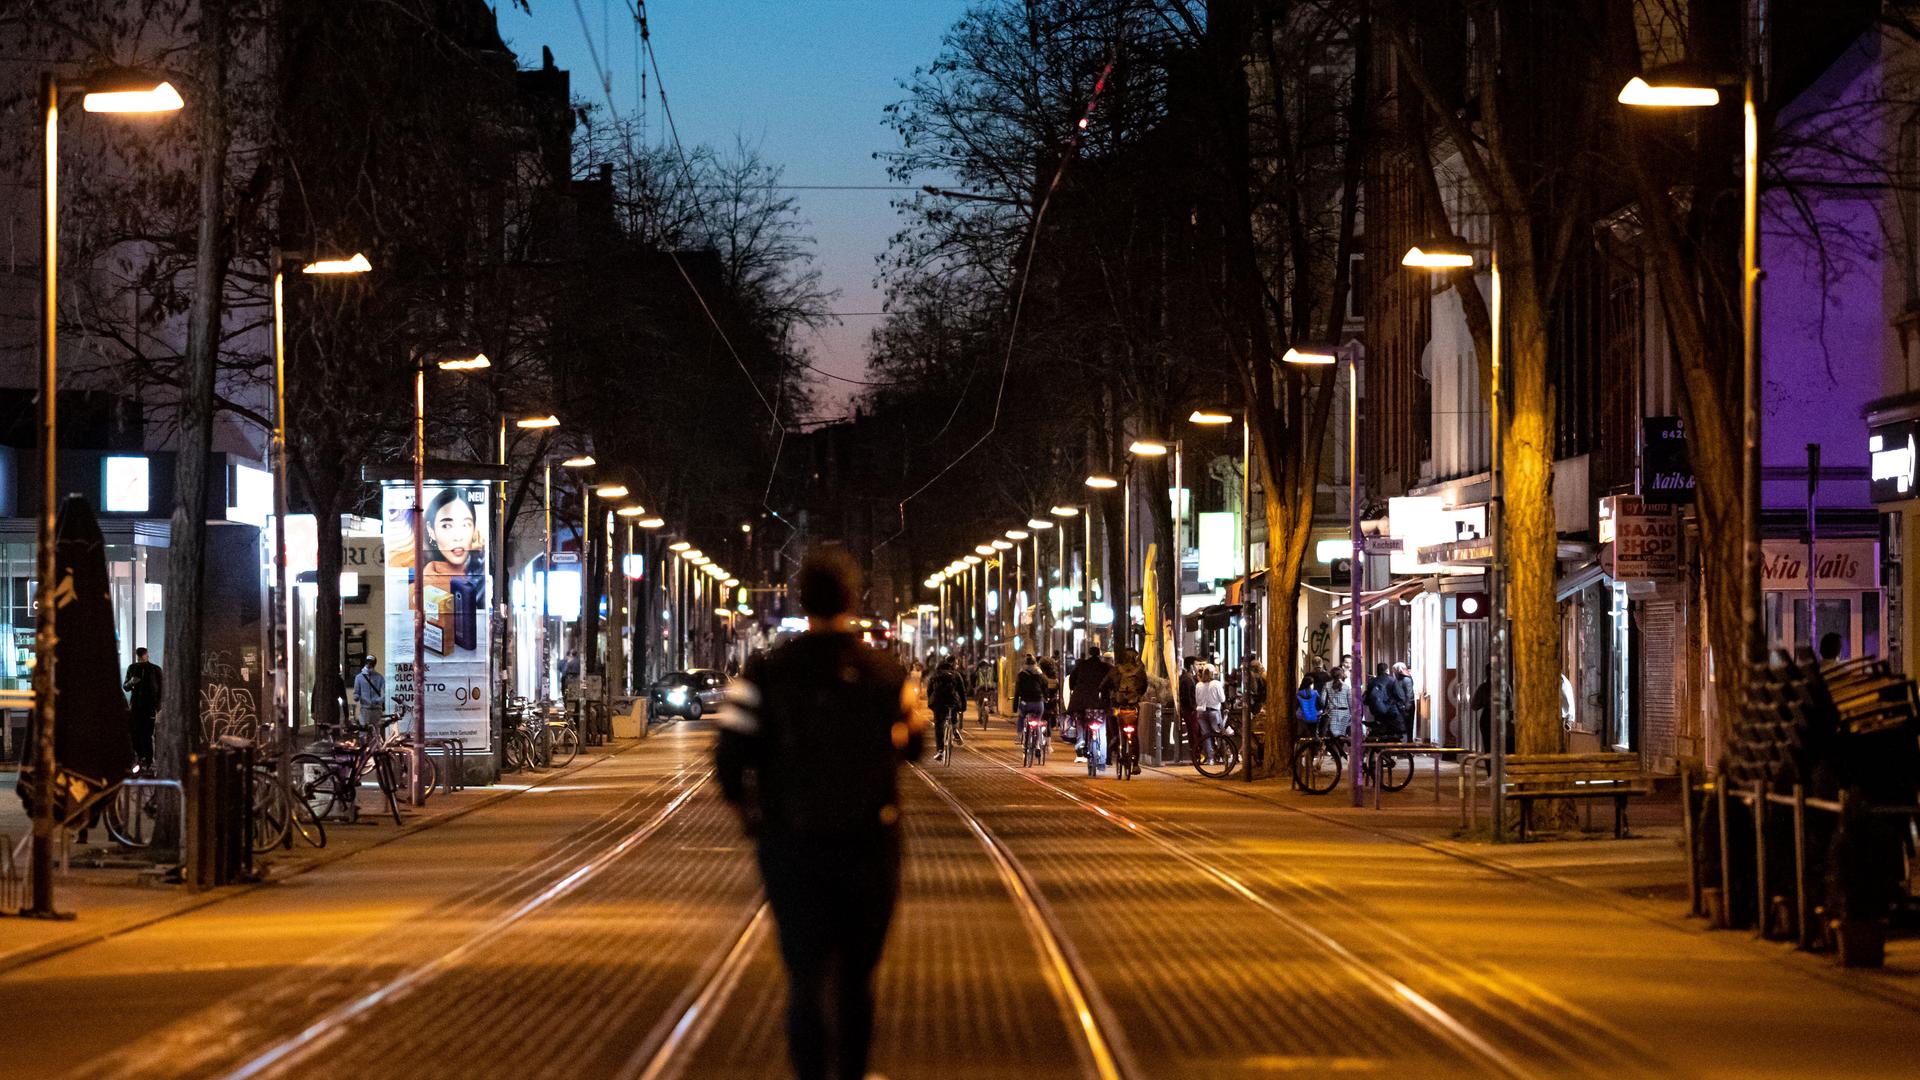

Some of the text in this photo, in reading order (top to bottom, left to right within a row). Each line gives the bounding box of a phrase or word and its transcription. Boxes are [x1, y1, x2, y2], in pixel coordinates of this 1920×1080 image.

[1652, 472, 1696, 490] Nails &
[467, 491, 484, 503] NEU
[1622, 539, 1673, 552] SHOP
[394, 683, 446, 692] AMATTO
[455, 677, 481, 706] glo
